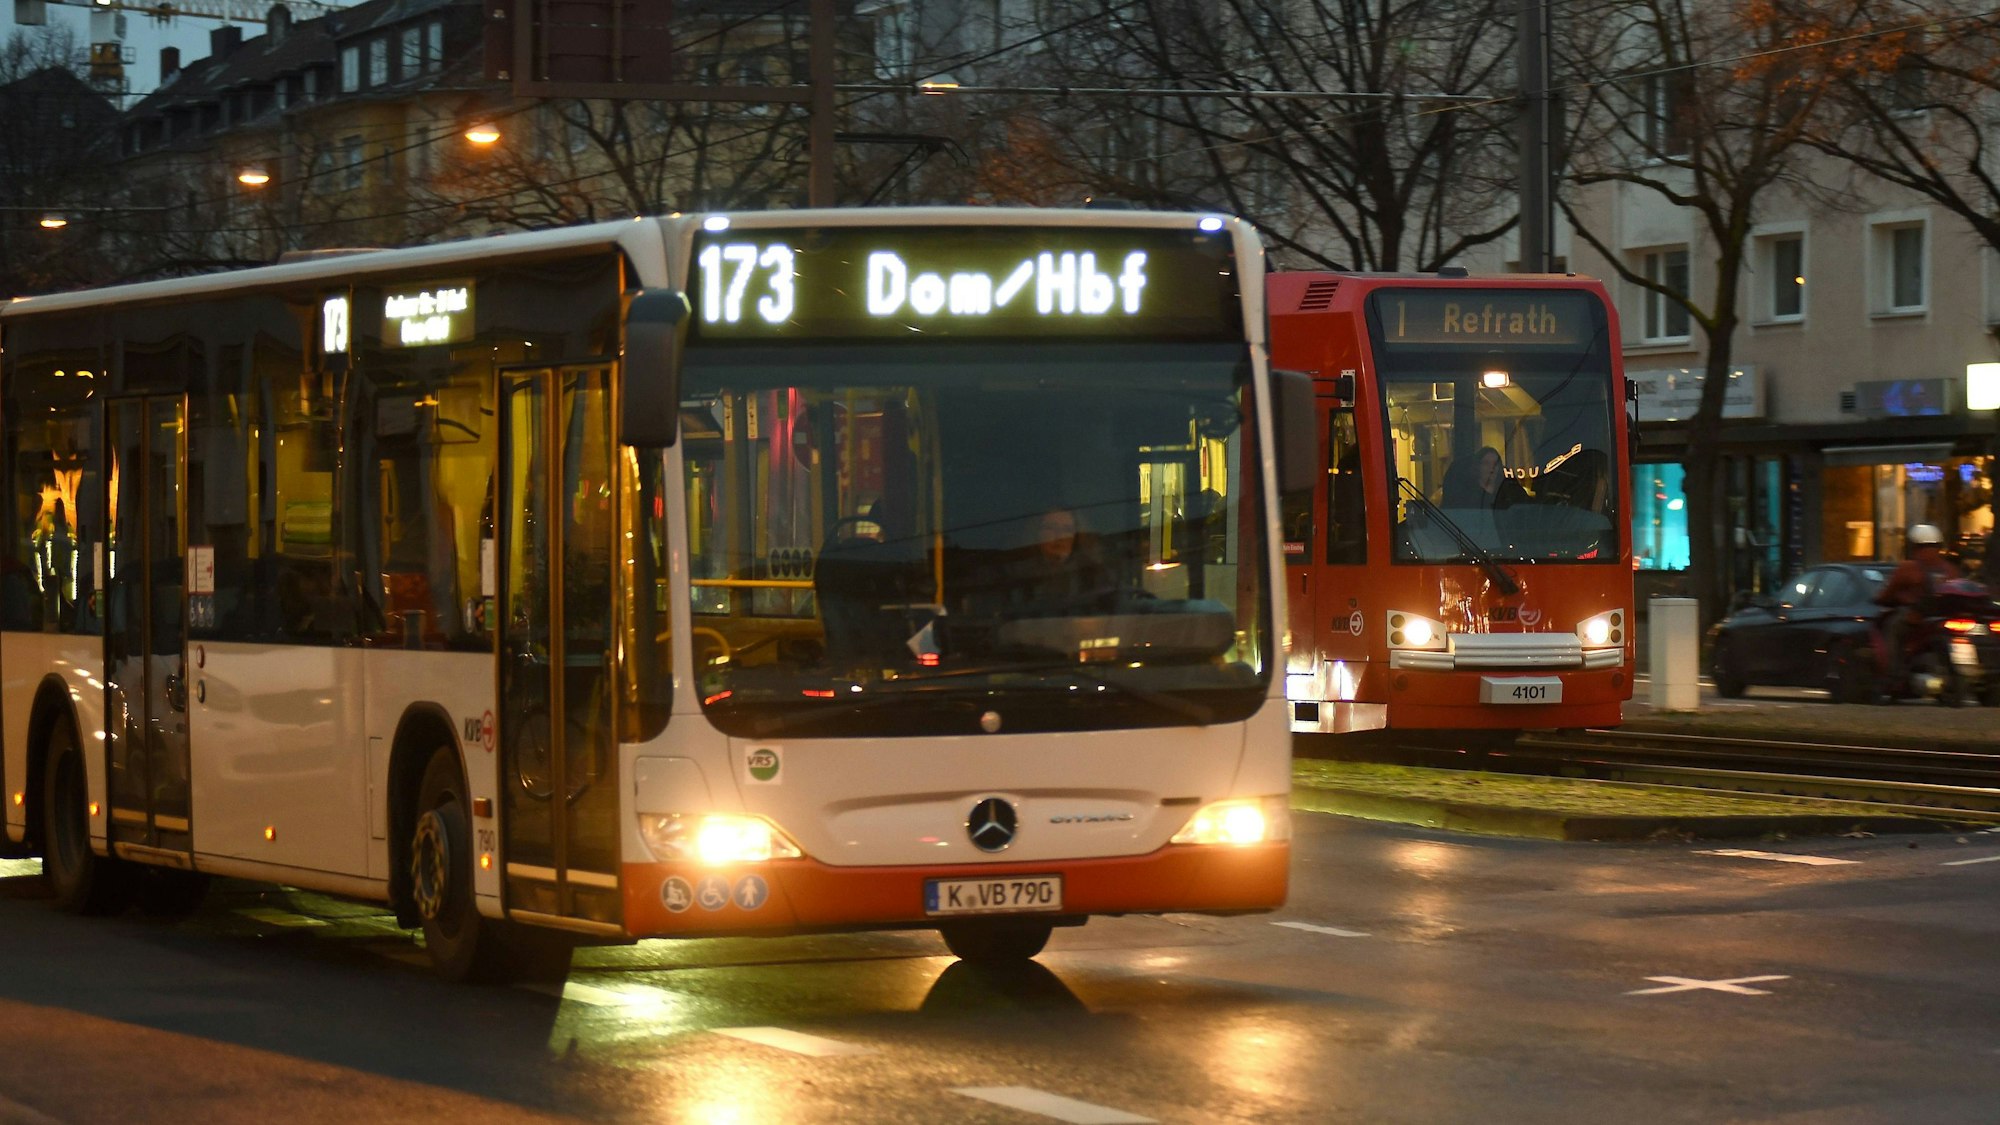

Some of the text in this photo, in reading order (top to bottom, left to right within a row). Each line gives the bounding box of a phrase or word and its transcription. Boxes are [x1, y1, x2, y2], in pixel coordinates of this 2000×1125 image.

[699, 243, 1147, 323] 173 Dom/Hbf
[1397, 300, 1556, 337] 1 Refrath
[1488, 606, 1518, 620] KVB
[1512, 686, 1546, 699] 4101
[464, 717, 482, 742] KVB
[747, 755, 772, 767] VRS
[478, 829, 495, 852] 790
[948, 884, 962, 907] K
